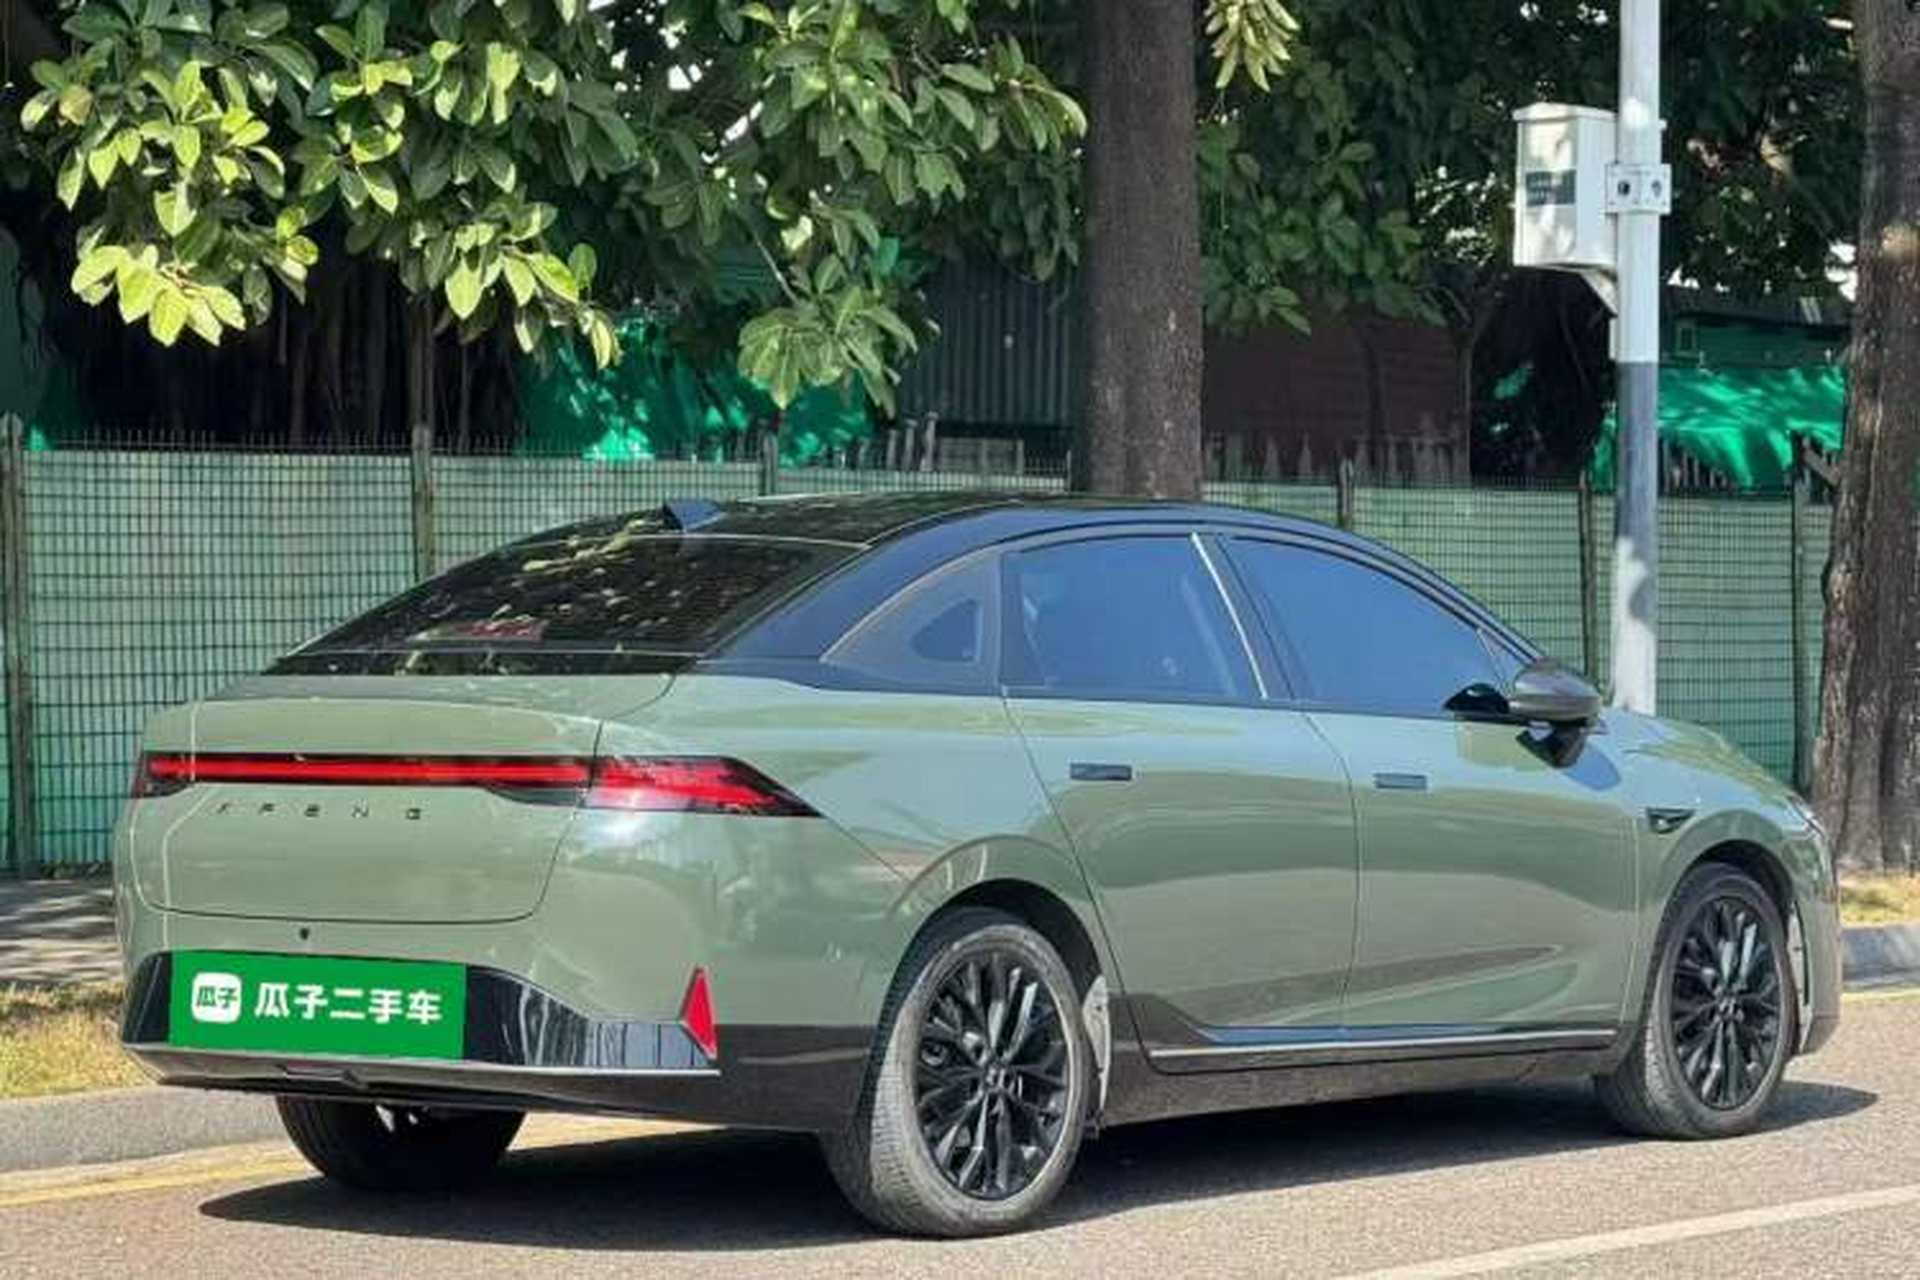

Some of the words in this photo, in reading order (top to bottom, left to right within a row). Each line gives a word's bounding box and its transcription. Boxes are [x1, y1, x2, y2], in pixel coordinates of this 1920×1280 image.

[196, 985, 238, 1010] 瓜子
[254, 982, 442, 1025] 瓜子二手车
